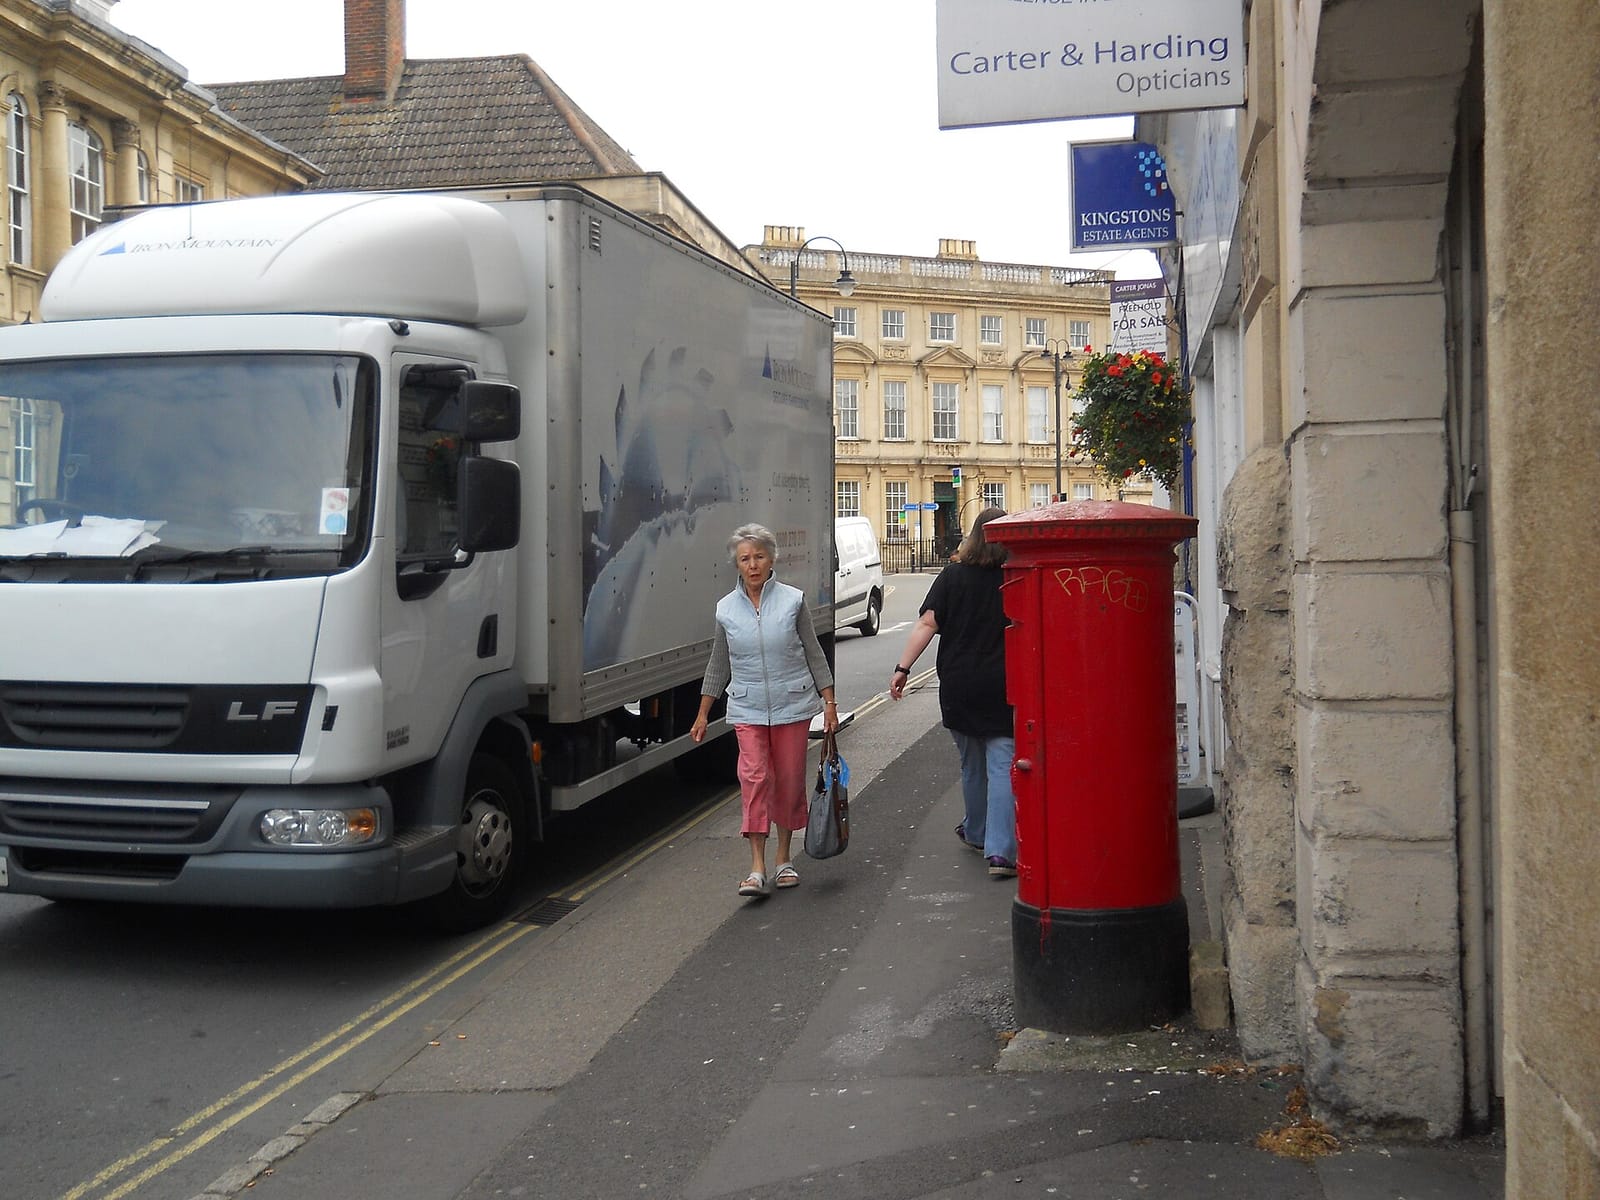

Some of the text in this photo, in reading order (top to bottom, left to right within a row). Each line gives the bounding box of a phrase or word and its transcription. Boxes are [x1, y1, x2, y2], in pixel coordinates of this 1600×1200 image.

[950, 34, 1230, 75] Carter & Harding
[1116, 67, 1231, 97] Opticians
[1081, 208, 1171, 226] KINGSTONS
[1083, 227, 1169, 242] ESTATE AGENTS
[1115, 282, 1157, 293] CARTER JONAS
[1118, 302, 1162, 313] FREEHOLD
[1113, 316, 1166, 331] FOR SALE
[227, 701, 298, 721] LF
